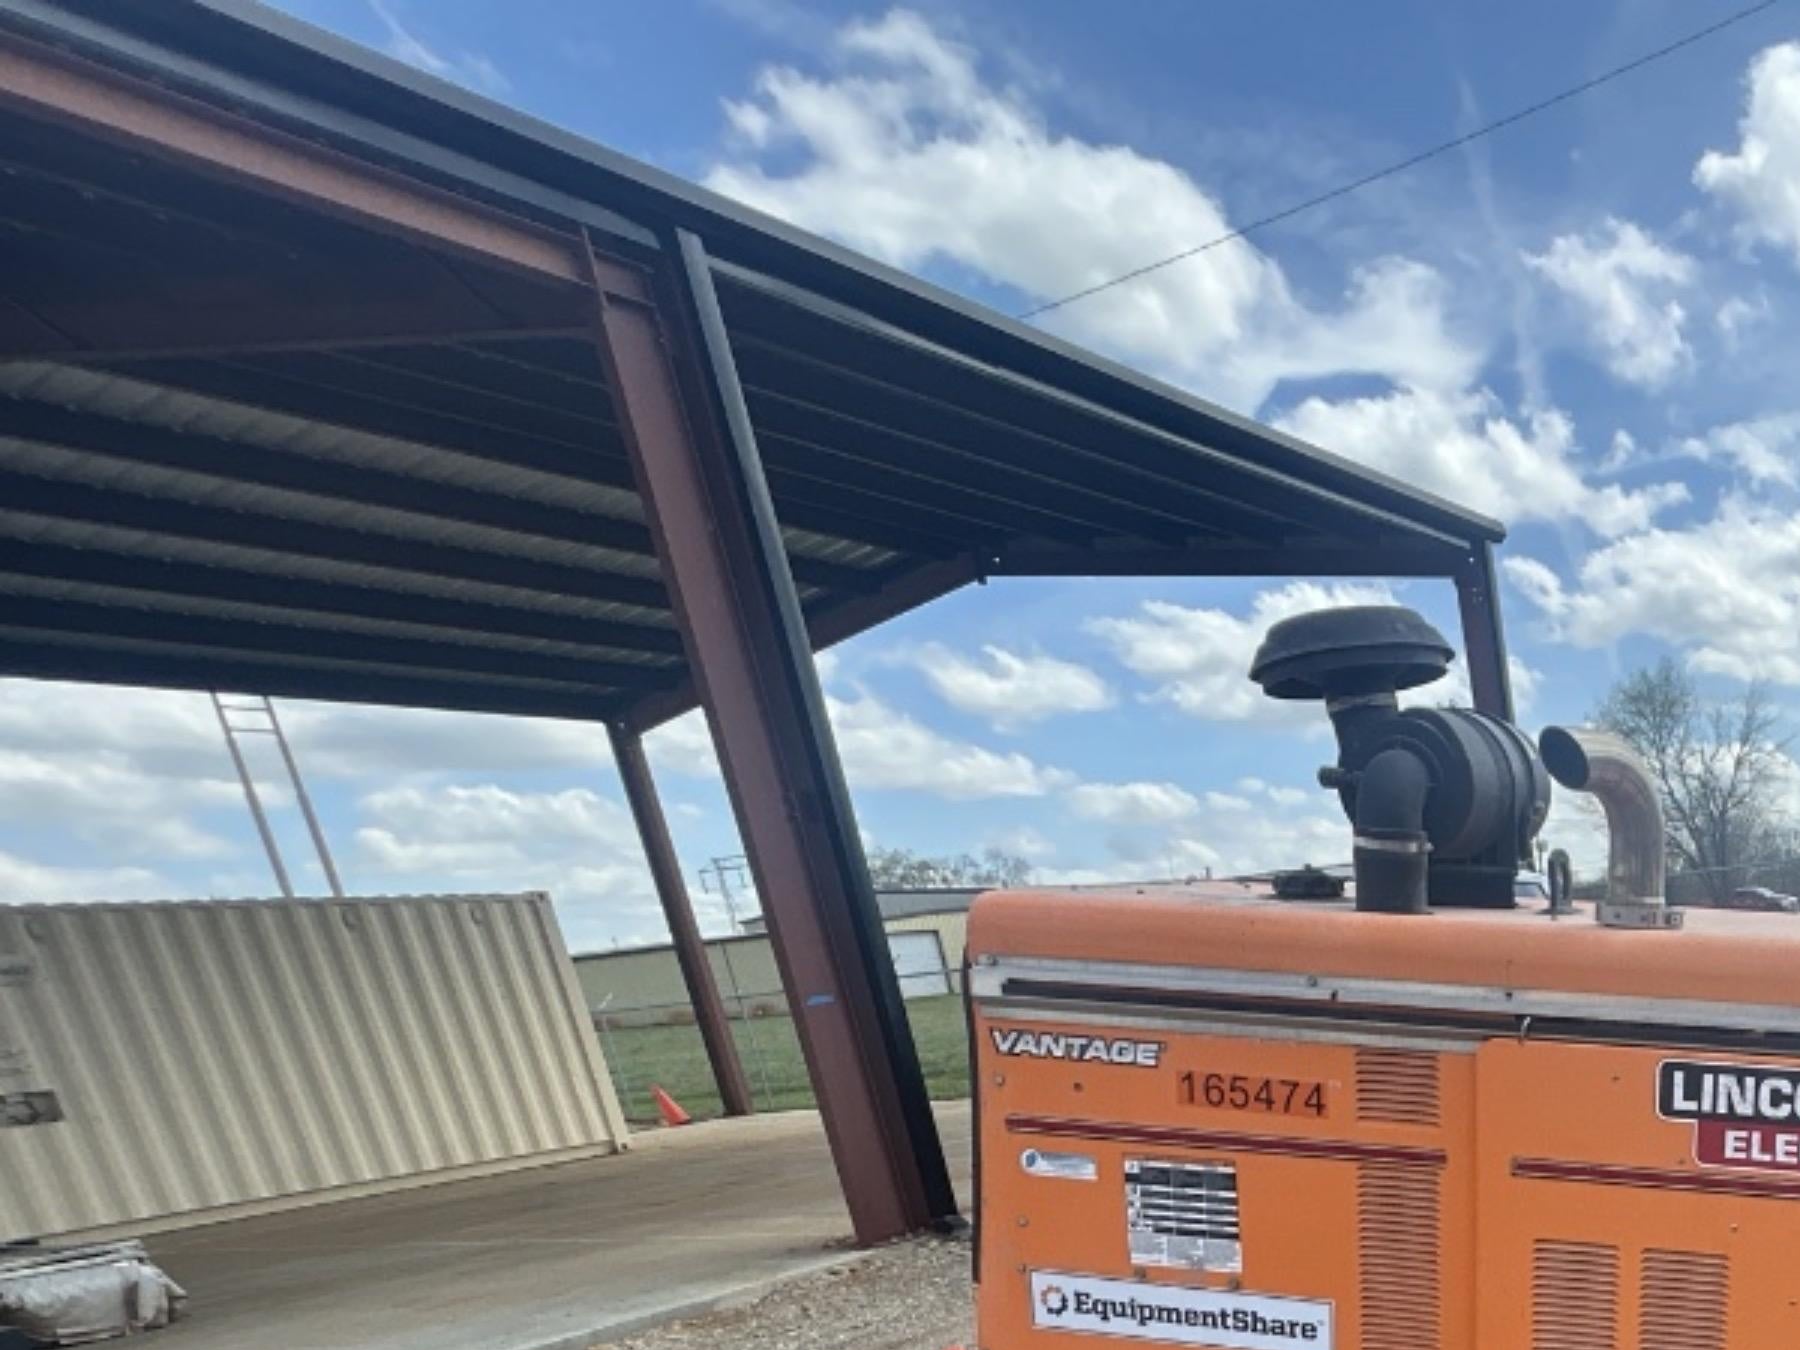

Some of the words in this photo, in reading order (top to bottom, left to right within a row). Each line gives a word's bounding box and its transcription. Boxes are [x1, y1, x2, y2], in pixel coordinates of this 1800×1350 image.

[991, 1028, 1162, 1067] VANTAGE
[1180, 1071, 1327, 1117] 165474
[1073, 1291, 1318, 1340] EquipmentShare
